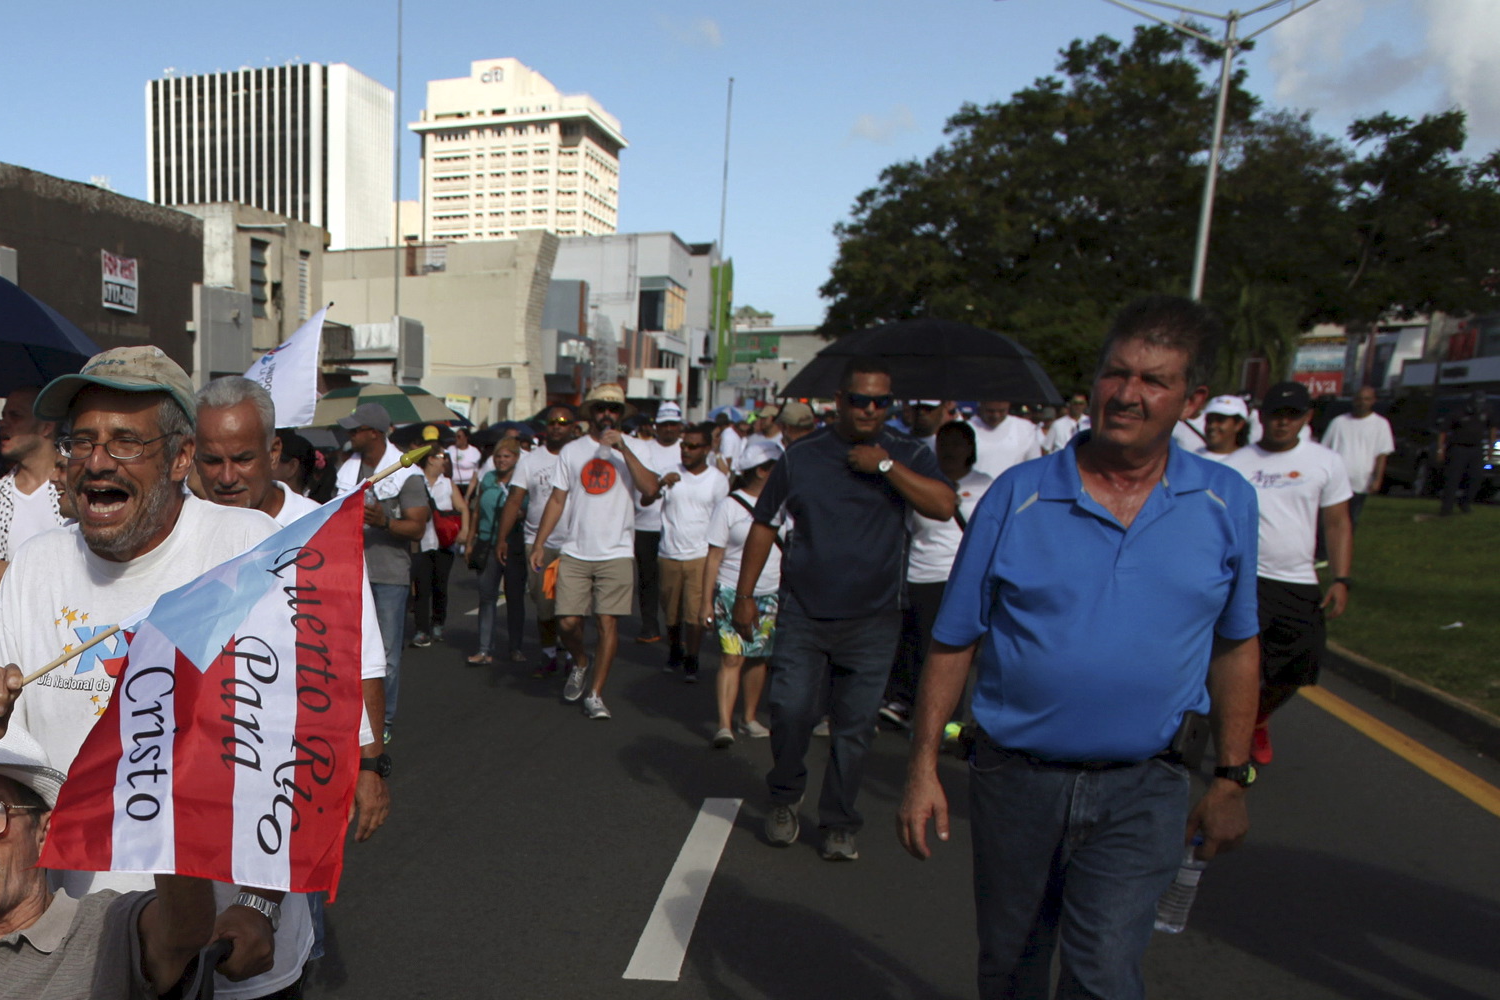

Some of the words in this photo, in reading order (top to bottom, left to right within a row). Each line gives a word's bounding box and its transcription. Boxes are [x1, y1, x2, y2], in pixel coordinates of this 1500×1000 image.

[52, 674, 95, 691] Nacional
[95, 678, 111, 692] de
[266, 546, 339, 714] Puerto
[124, 665, 180, 823] Cristo
[219, 635, 281, 771] Para
[256, 732, 337, 856] Rico
